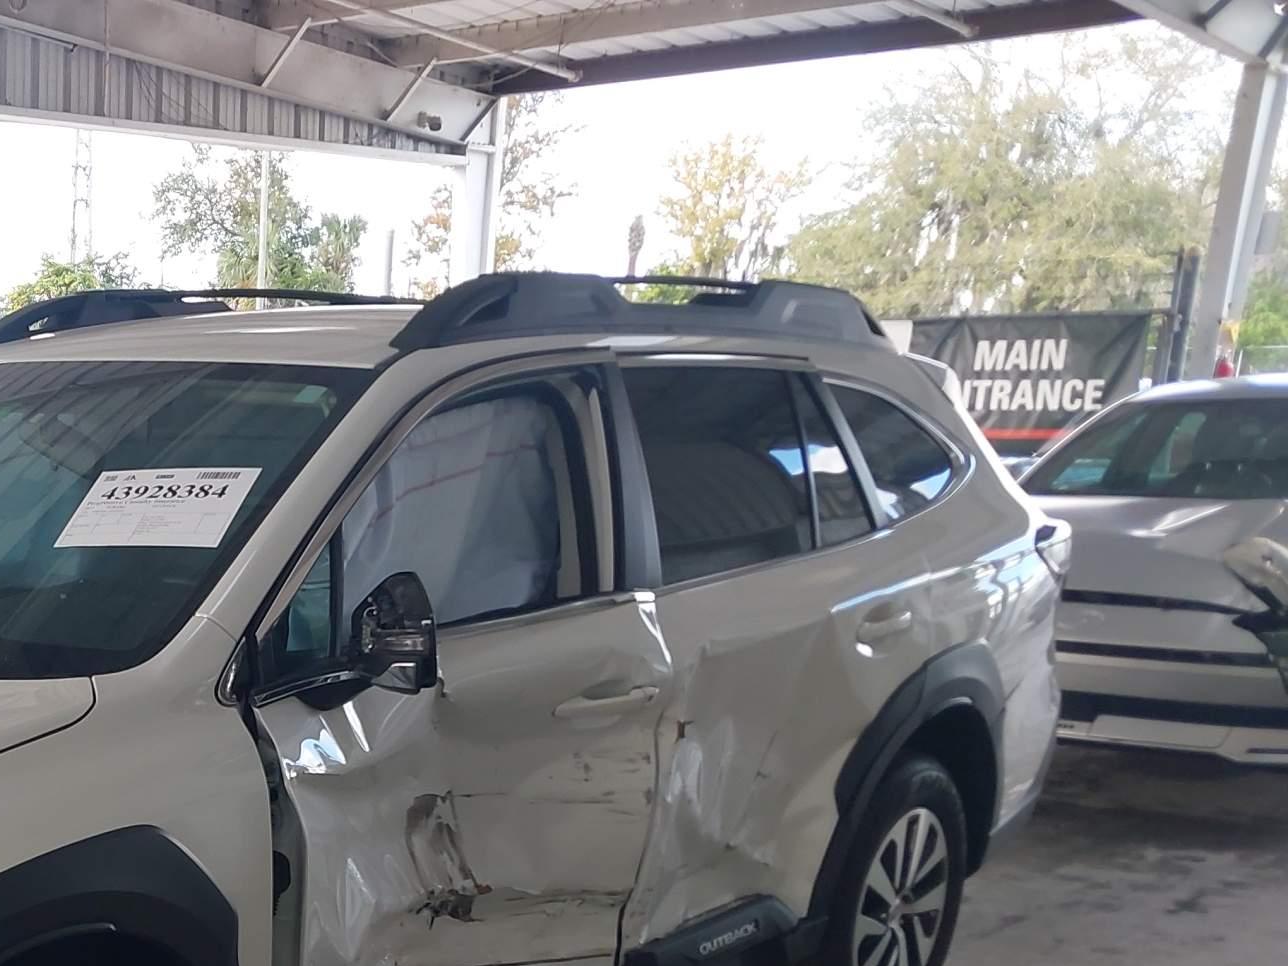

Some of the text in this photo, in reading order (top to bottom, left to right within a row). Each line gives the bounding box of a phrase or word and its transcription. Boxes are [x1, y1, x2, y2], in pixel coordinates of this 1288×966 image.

[973, 338, 1068, 371] MAIN
[958, 378, 1105, 411] NTRANCE
[100, 483, 229, 500] 43928384
[699, 922, 757, 956] OUTBACK
